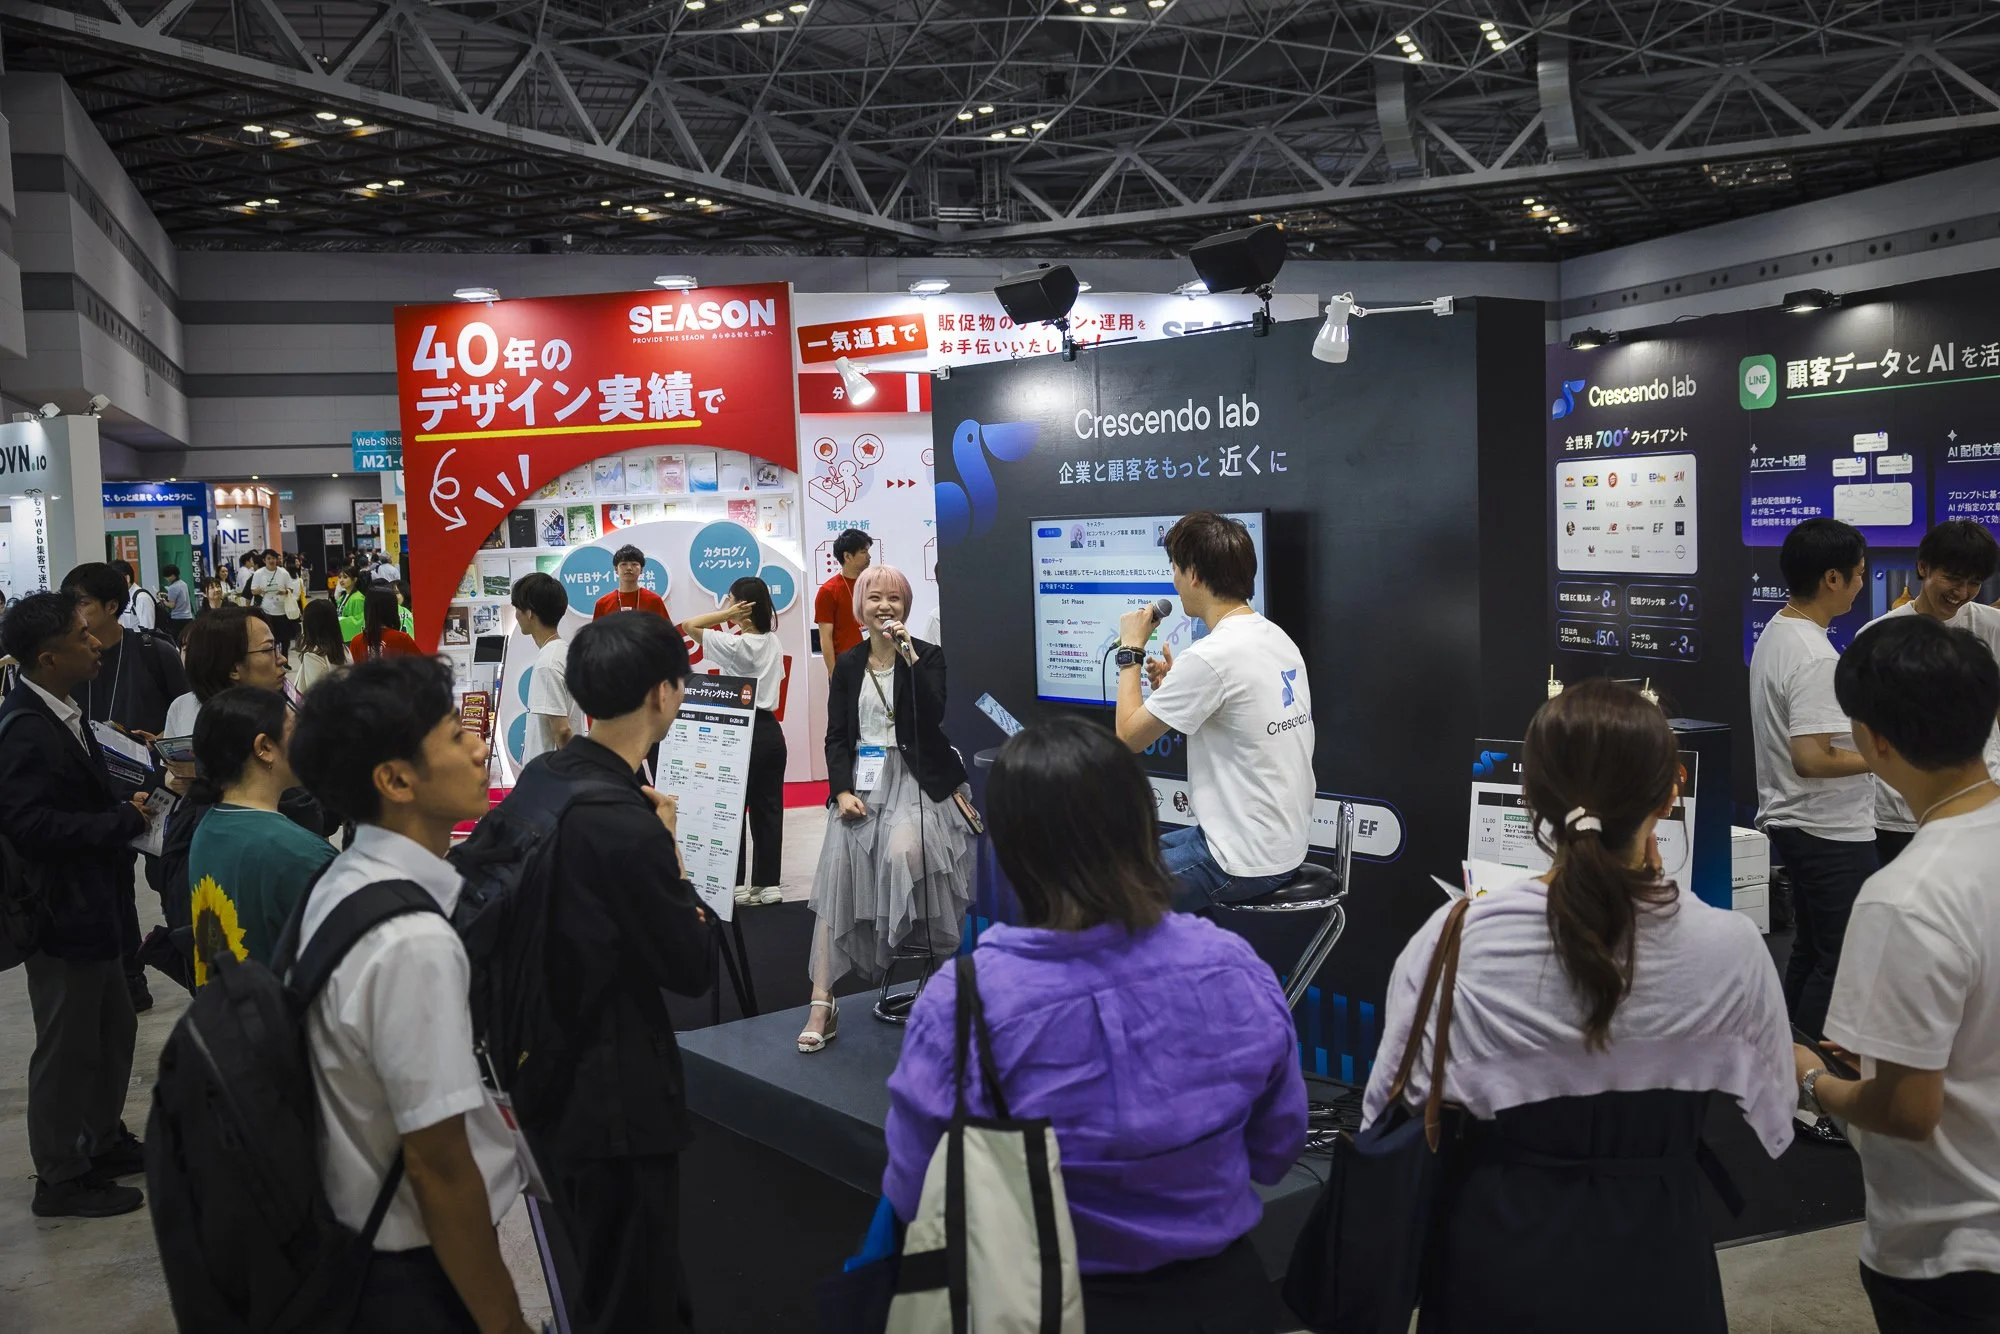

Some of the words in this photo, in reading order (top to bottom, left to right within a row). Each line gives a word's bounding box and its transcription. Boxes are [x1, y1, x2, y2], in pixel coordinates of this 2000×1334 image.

[629, 299, 776, 334] SEASON
[412, 321, 573, 380] 40年の
[632, 336, 663, 344] PROVIDE
[807, 323, 919, 353] 一気通貫で
[1589, 378, 1669, 408] Crescendo
[1672, 373, 1697, 399] lab
[1748, 374, 1768, 386] LINE
[416, 370, 727, 432] デザイン実績で
[1074, 398, 1211, 440] Crescendo
[1219, 393, 1260, 429] lab
[826, 519, 871, 532] 現状分析
[585, 585, 600, 596] LP
[1358, 819, 1379, 836] EF
